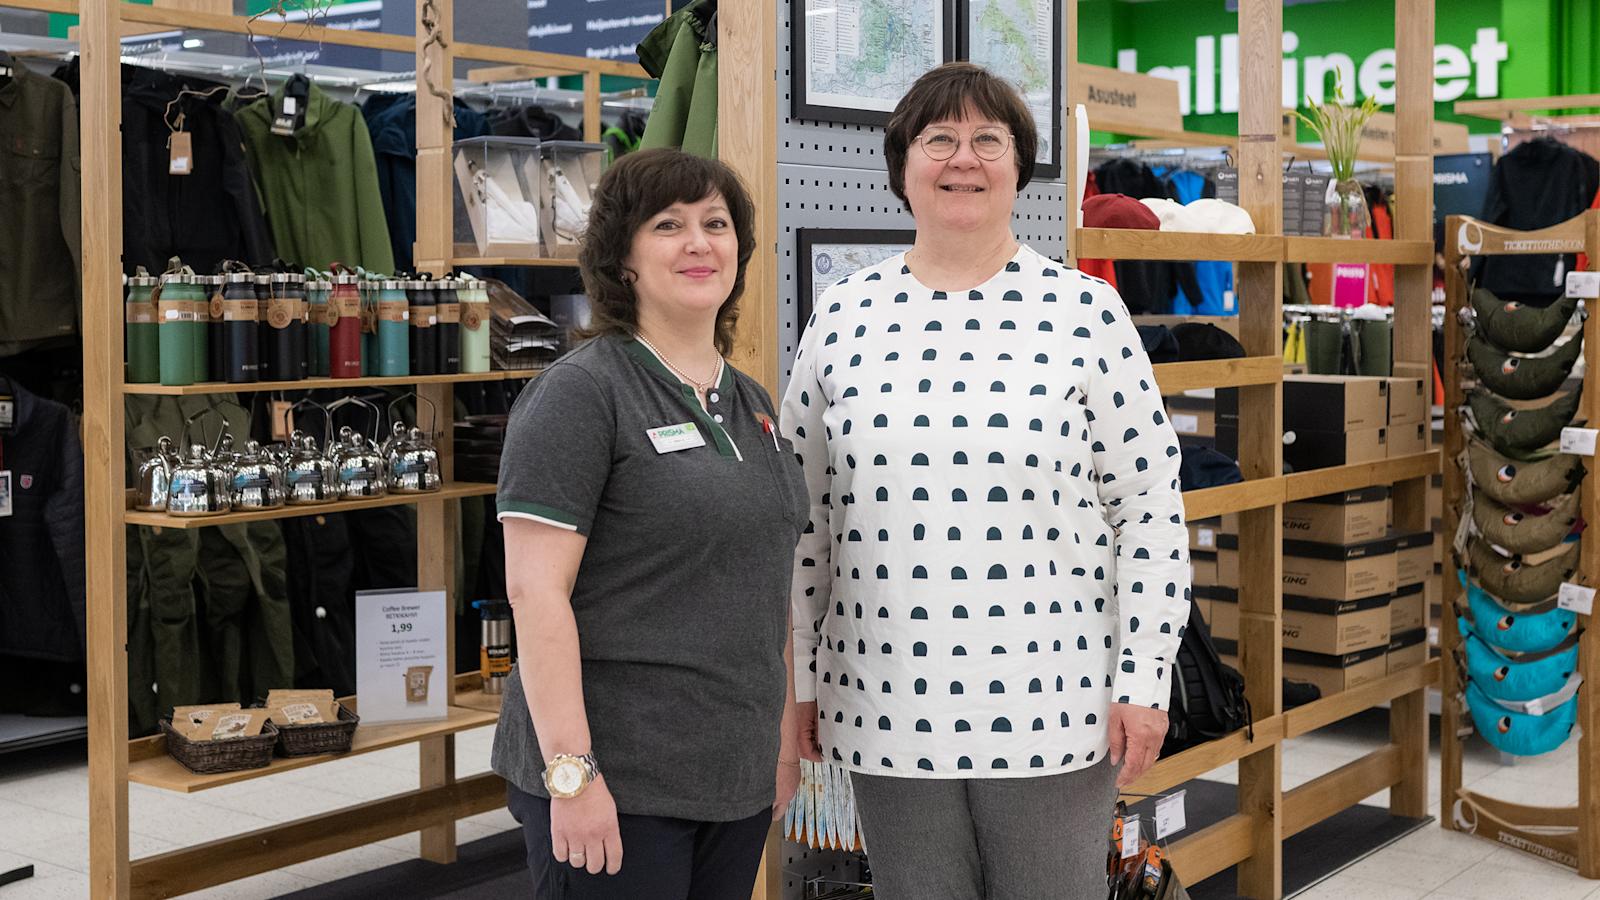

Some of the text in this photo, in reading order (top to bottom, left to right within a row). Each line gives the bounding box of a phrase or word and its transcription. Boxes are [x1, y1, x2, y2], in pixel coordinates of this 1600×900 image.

[1088, 84, 1136, 108] Asusteet
[657, 428, 685, 438] PRISMA
[391, 623, 413, 633] 1,99
